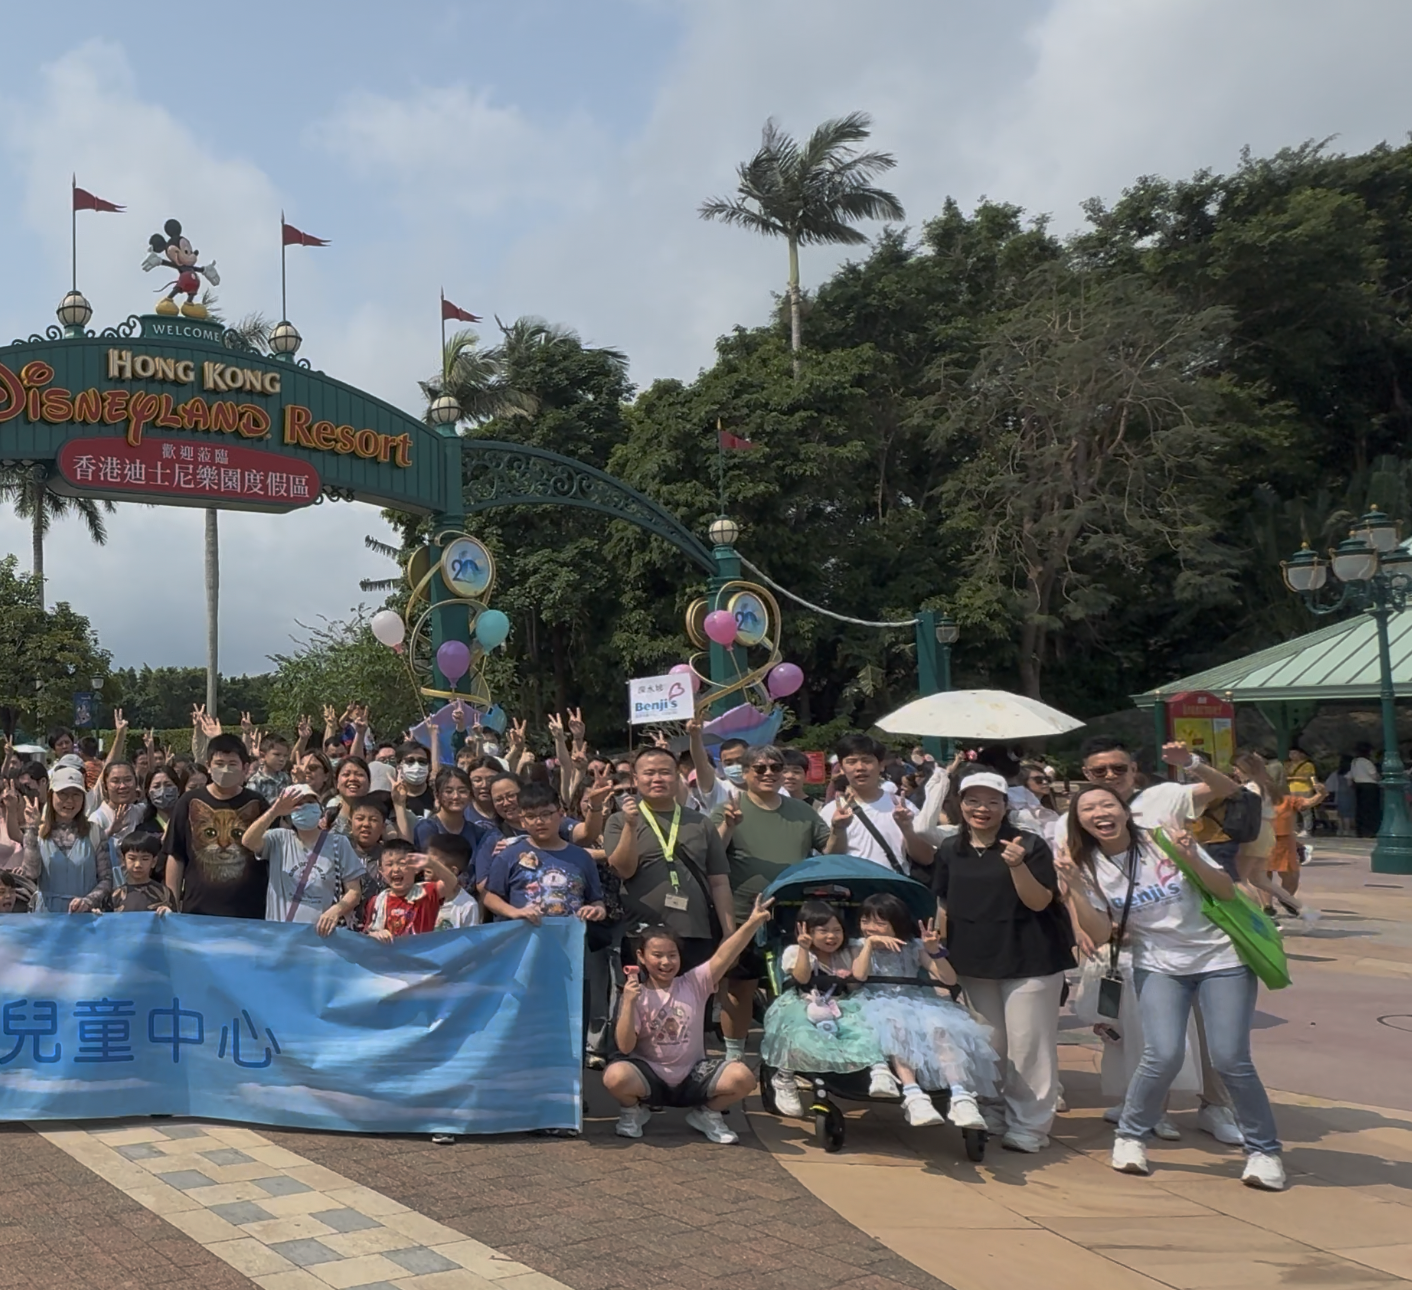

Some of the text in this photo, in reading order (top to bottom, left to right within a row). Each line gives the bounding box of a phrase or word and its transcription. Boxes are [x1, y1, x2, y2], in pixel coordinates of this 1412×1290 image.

[152, 324, 220, 342] WELCOME
[108, 349, 281, 394] HONG KONG
[162, 443, 229, 465] 歡迎蒞臨
[284, 404, 413, 467] Resort
[73, 454, 310, 499] 香港迪士尼樂園度假區
